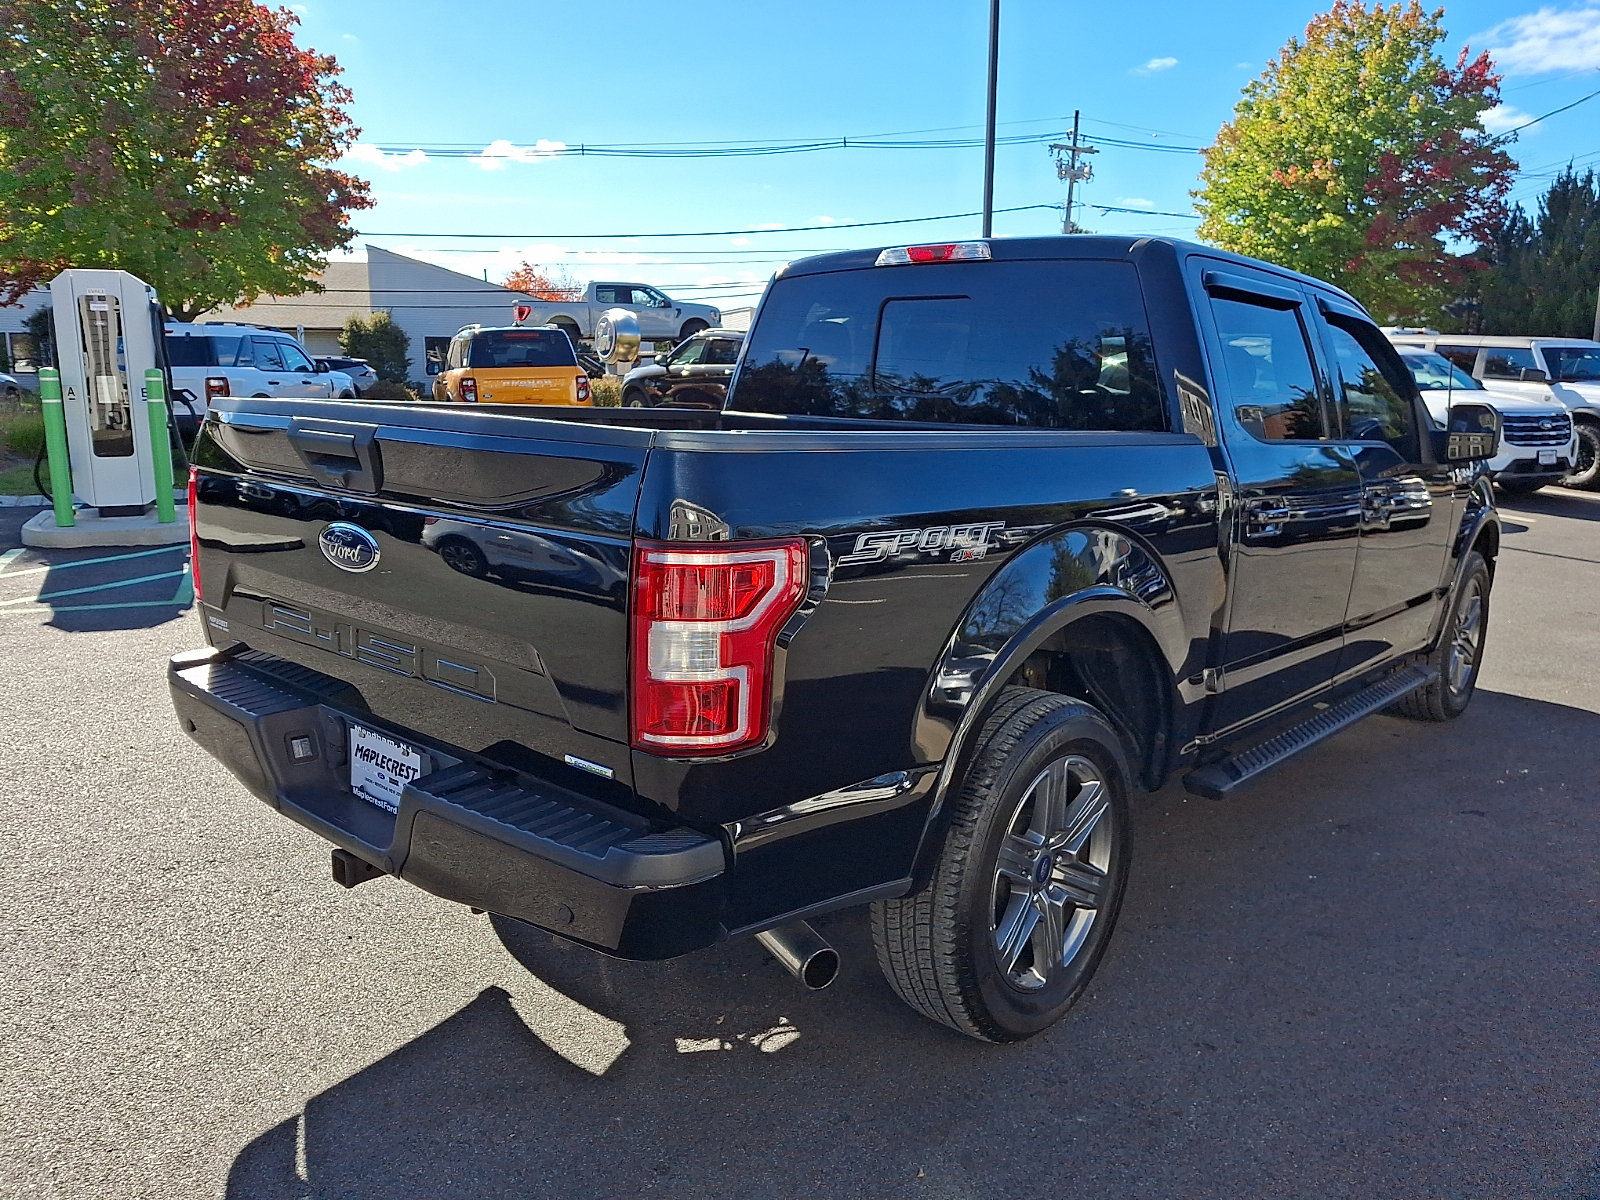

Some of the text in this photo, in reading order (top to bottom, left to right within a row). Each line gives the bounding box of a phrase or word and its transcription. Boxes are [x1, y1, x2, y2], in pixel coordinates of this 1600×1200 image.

[67, 386, 76, 397] A
[326, 529, 363, 563] Ford
[836, 521, 1006, 567] SPORT
[262, 599, 498, 704] F-150
[354, 724, 413, 753] Mendham, NJ
[354, 743, 418, 781] MAPLECREST
